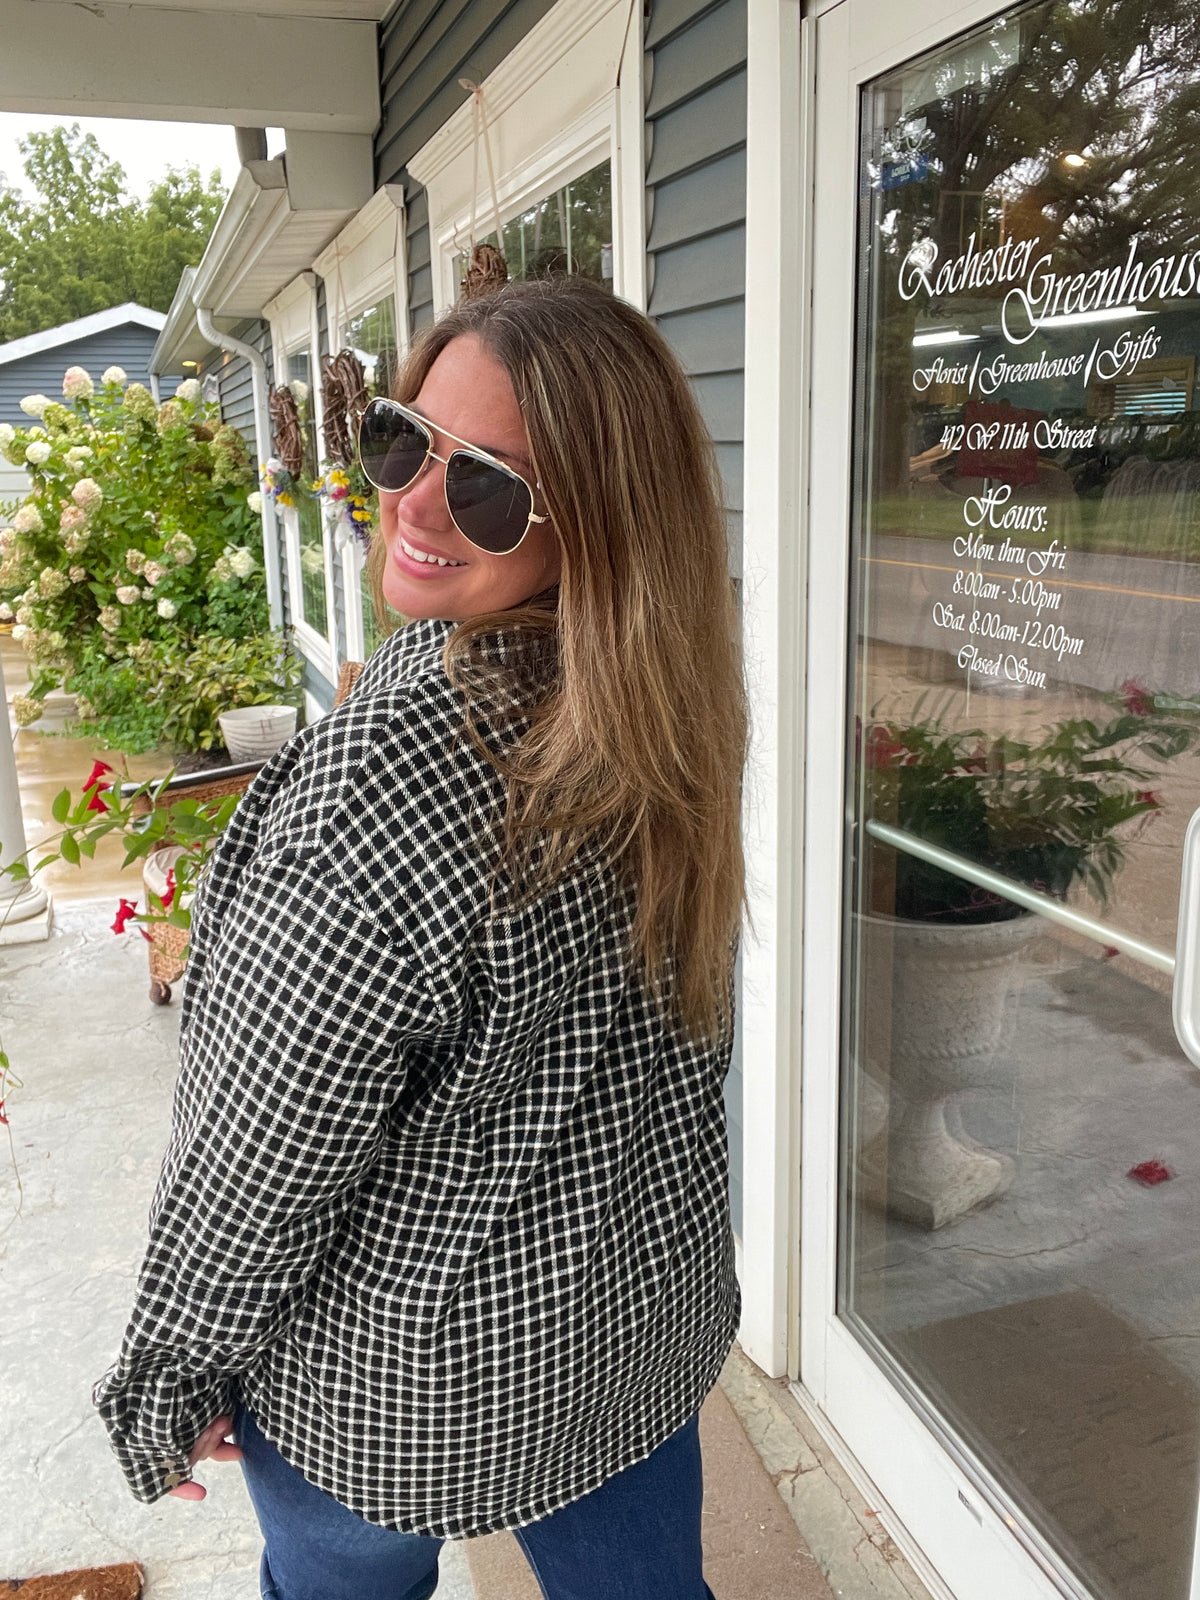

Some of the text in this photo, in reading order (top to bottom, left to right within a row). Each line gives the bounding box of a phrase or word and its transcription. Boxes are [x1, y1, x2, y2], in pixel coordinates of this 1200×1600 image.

[898, 231, 1040, 301] Rochester
[1001, 237, 1200, 345] Greenhous
[912, 357, 968, 391] Florist
[978, 350, 1083, 395] Greenhouse
[1096, 325, 1162, 380] Gifts
[939, 418, 1098, 451] 412 W. 11th Street
[963, 484, 1048, 532] Hours:
[953, 532, 1067, 576] Mon. thru Fri.
[952, 570, 1000, 600] 8:00am
[1008, 578, 1062, 617] 5:00pm
[932, 602, 1085, 662] Sat. 8:00am-12:00pm
[957, 644, 1047, 690] Closed Sun.
